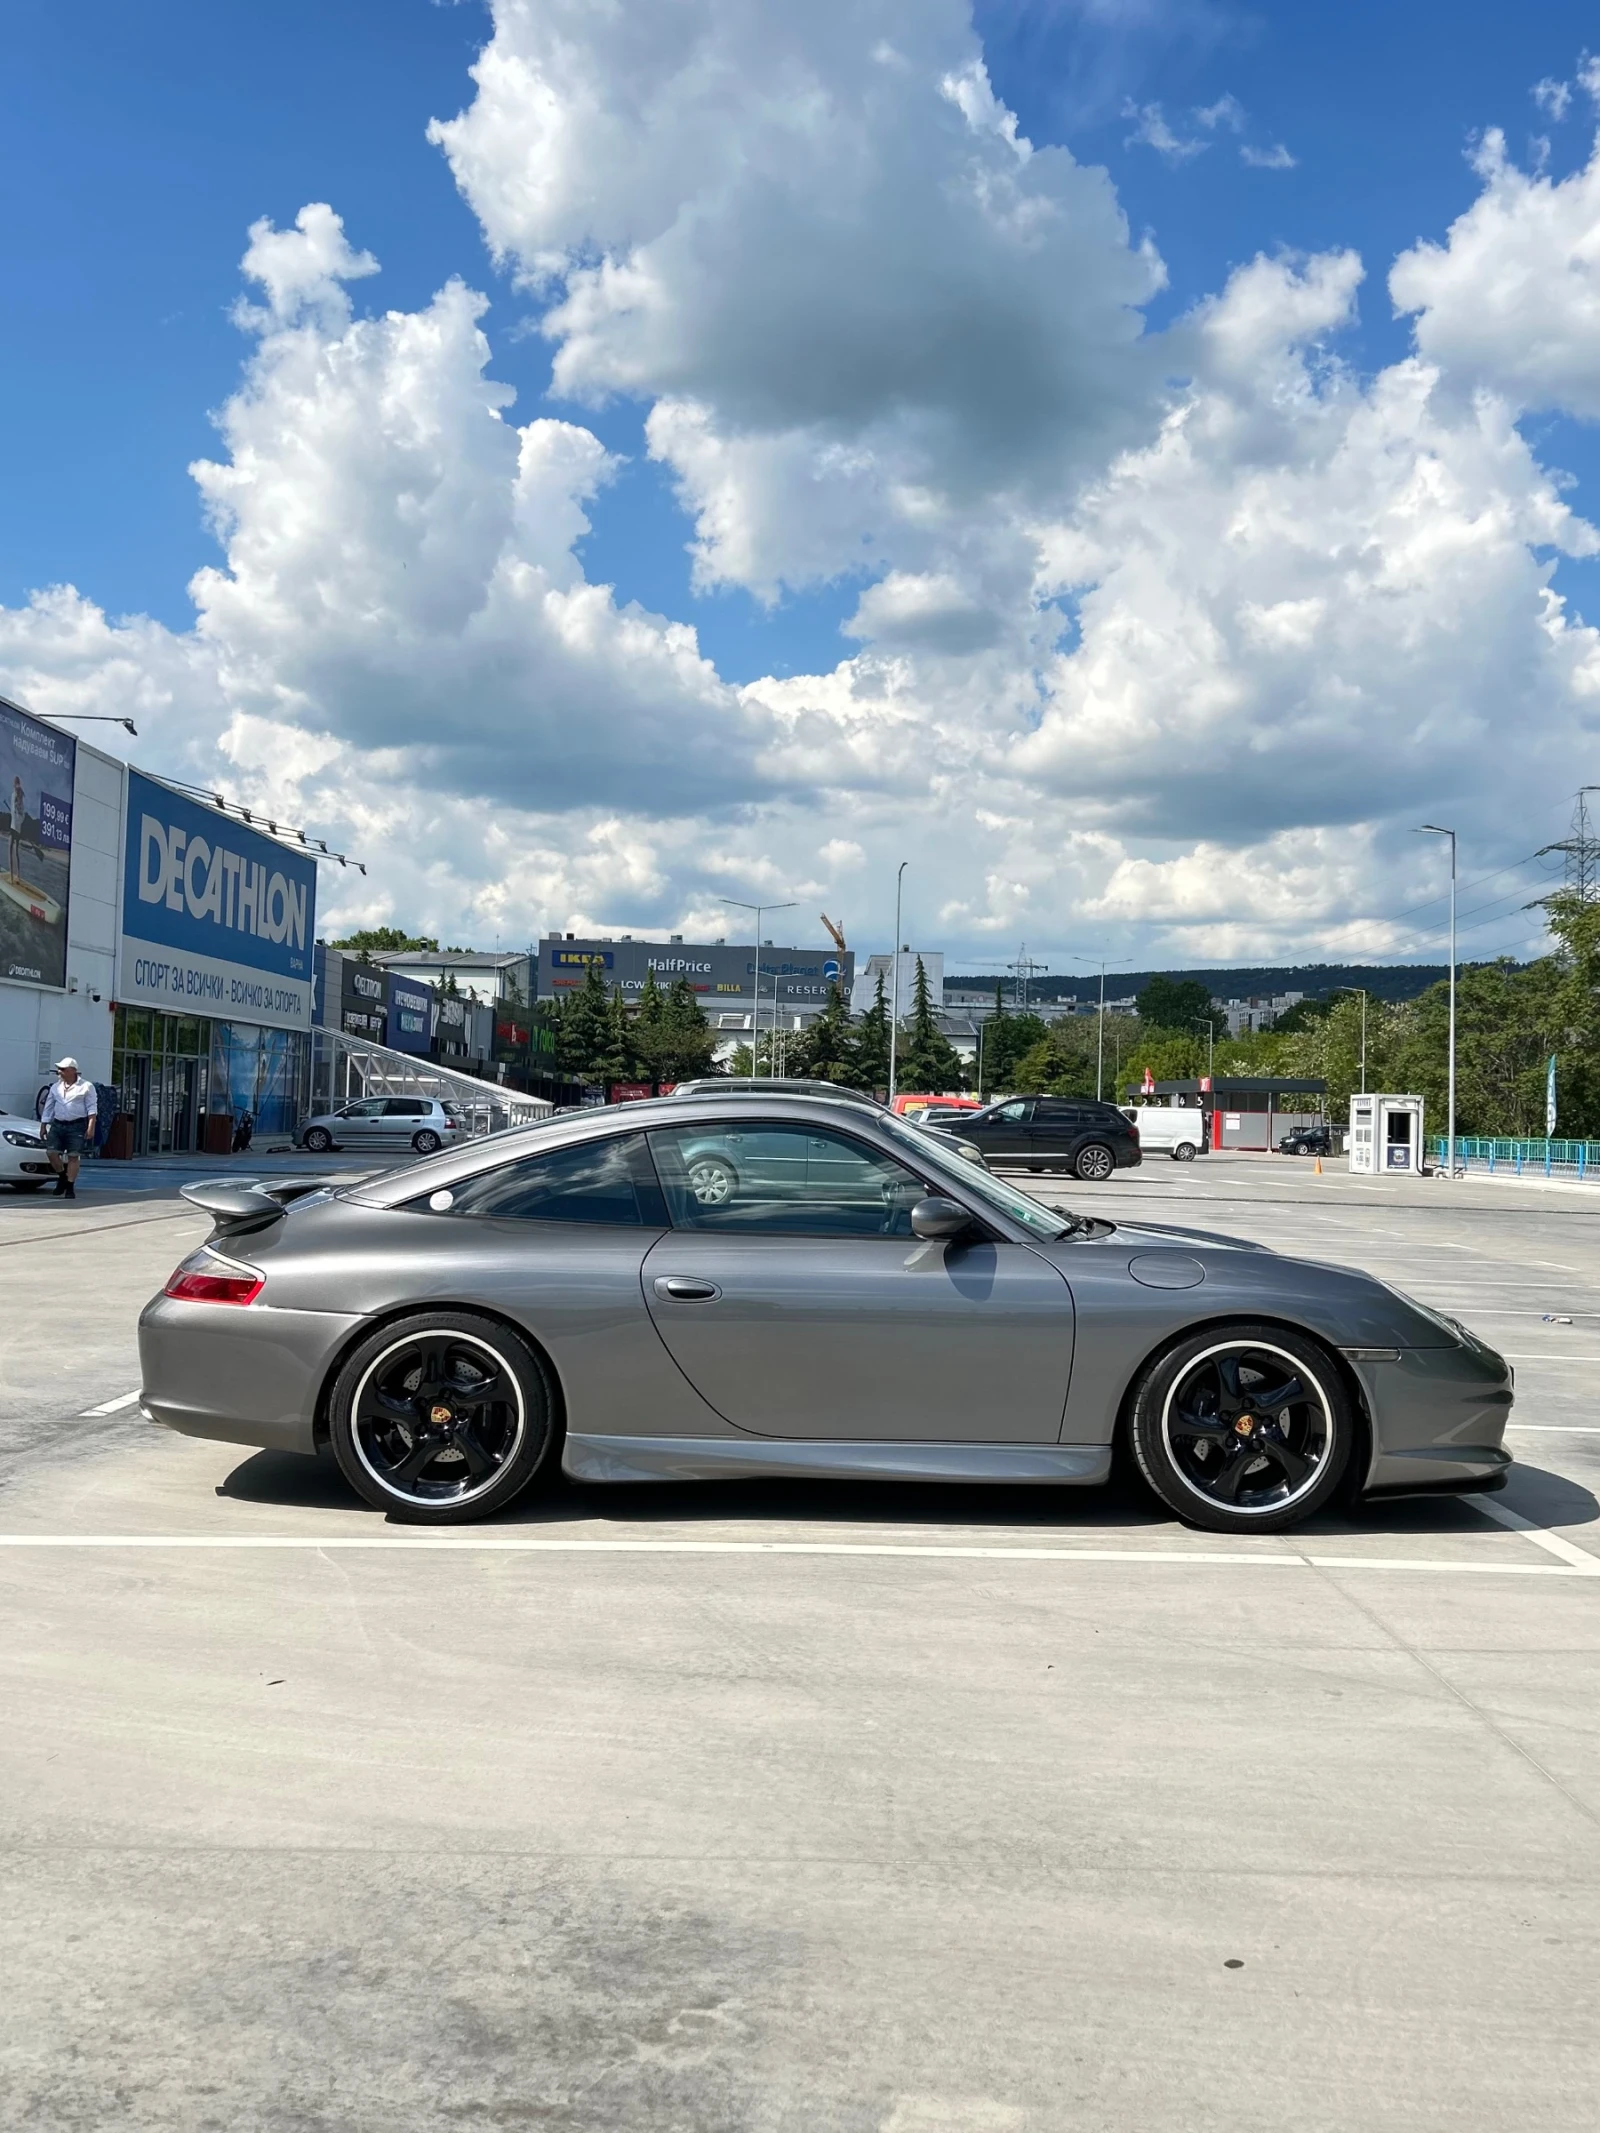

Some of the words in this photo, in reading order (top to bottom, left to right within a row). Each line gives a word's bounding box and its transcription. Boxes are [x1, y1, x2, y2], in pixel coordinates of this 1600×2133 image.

[20, 721, 56, 749] Комплект
[13, 735, 48, 760] надуваем
[49, 750, 64, 766] SUP
[43, 802, 64, 823] 199,99
[65, 814, 70, 825] €
[41, 820, 62, 841] 391,13
[139, 813, 307, 951] DECATHLON
[560, 953, 605, 965] IKEA
[648, 958, 712, 973] HalfPrice
[15, 965, 42, 979] DECATHLON
[135, 959, 170, 990] СПОРТ
[172, 967, 185, 994] ЗА
[187, 970, 223, 1000] ВСИЧКИ
[231, 979, 263, 1007] ВСИЧКО
[264, 988, 273, 1010] ЗА
[275, 990, 302, 1015] СПОРТА
[716, 983, 742, 993] BILLA
[1129, 1099, 1133, 1107] 1
[1142, 1098, 1148, 1107] 2
[1156, 1098, 1162, 1107] 3
[1179, 1098, 1186, 1106] 4
[1196, 1096, 1204, 1106] 5
